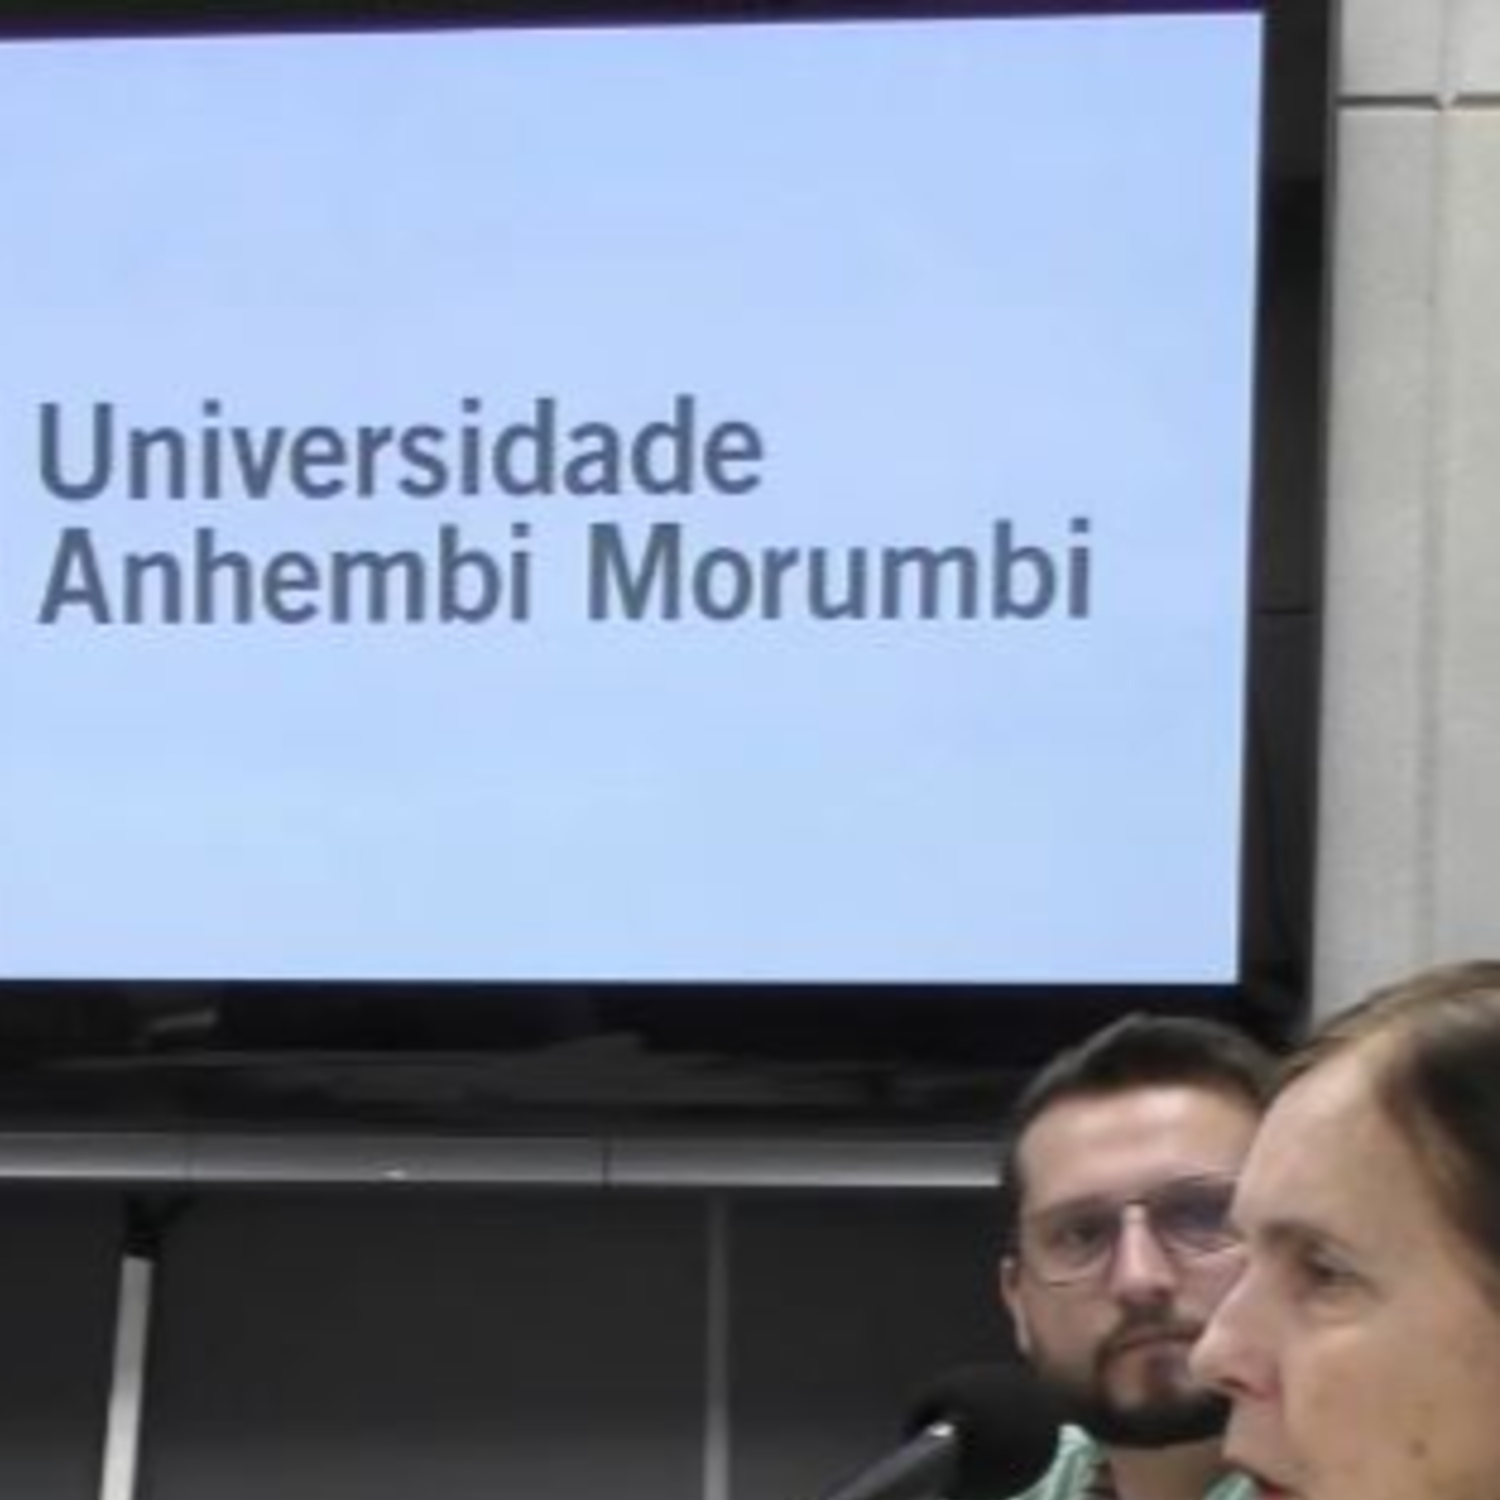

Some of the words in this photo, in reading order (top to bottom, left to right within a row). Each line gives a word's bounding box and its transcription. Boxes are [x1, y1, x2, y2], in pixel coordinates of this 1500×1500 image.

[38, 393, 766, 502] Universidade
[37, 521, 532, 626] Anhembi
[587, 516, 1092, 623] Morumbi
